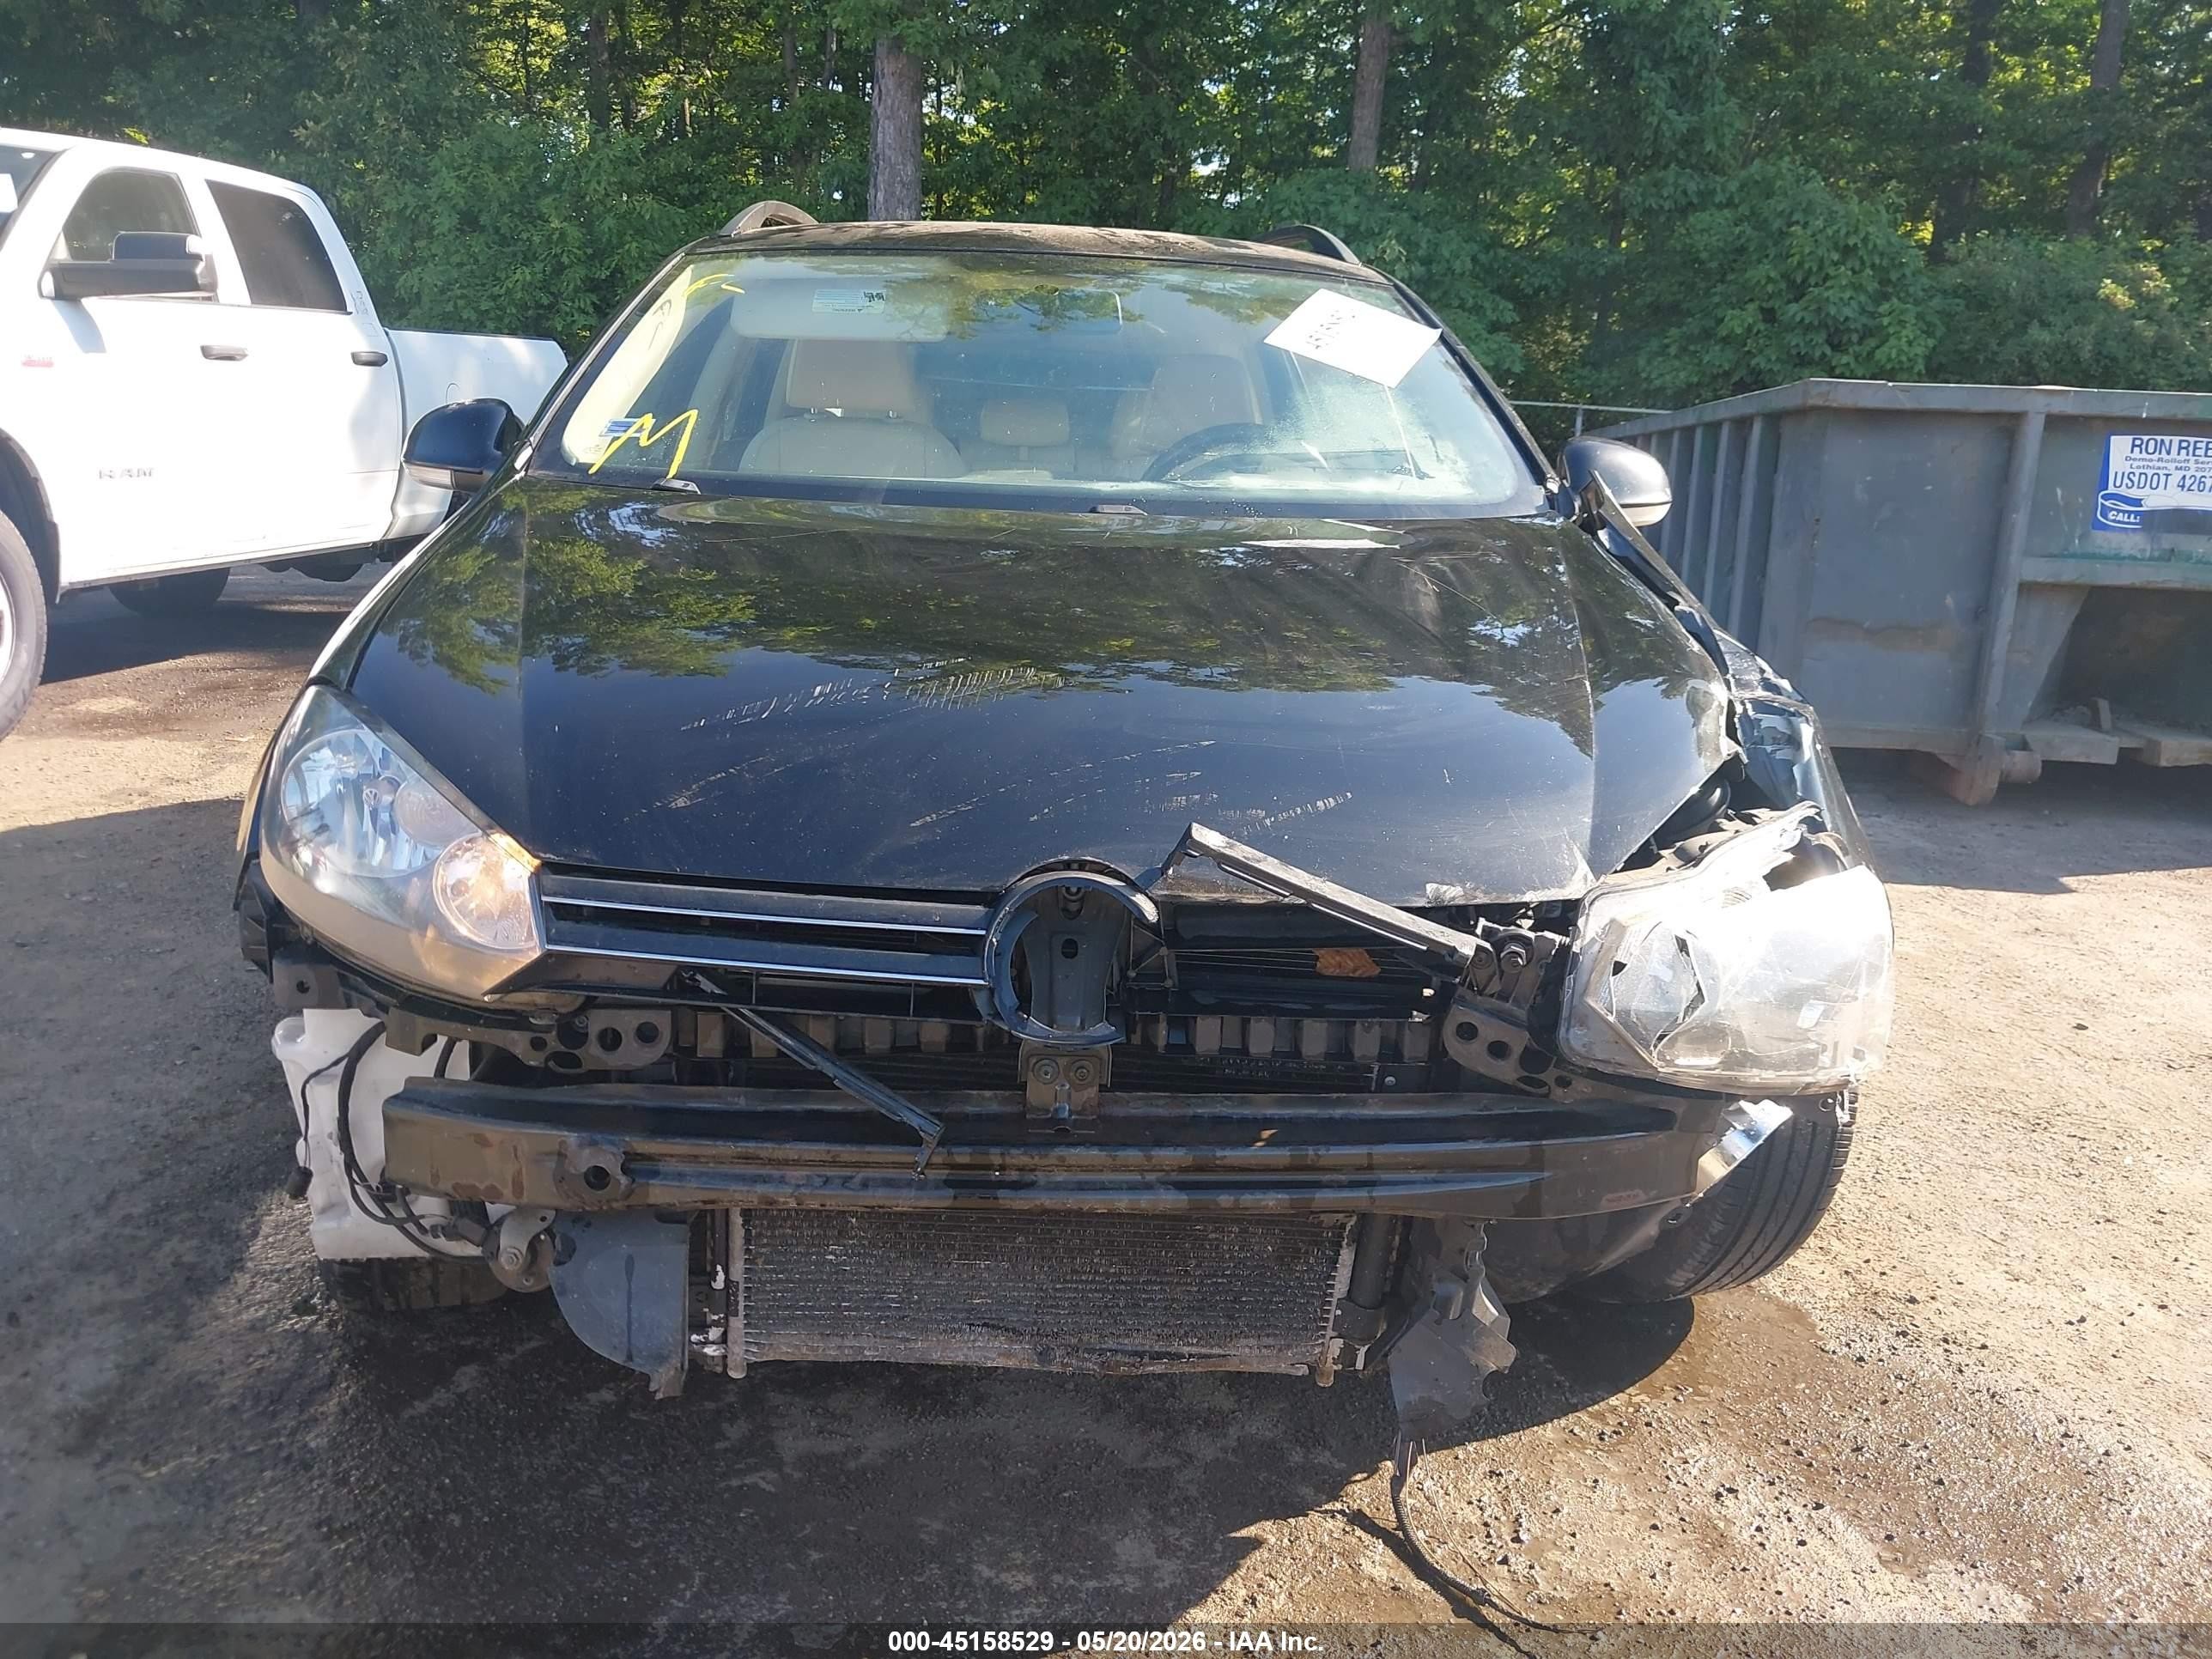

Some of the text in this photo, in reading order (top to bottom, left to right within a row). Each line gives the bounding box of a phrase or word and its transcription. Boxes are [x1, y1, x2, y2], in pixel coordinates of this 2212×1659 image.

[2130, 437, 2172, 456] RON
[2124, 455, 2191, 465] Demo-Rolloff
[99, 467, 153, 479] RAM
[2130, 463, 2172, 472] Lothian,
[2113, 471, 2173, 490] USDOT
[2108, 510, 2141, 523] CALL:
